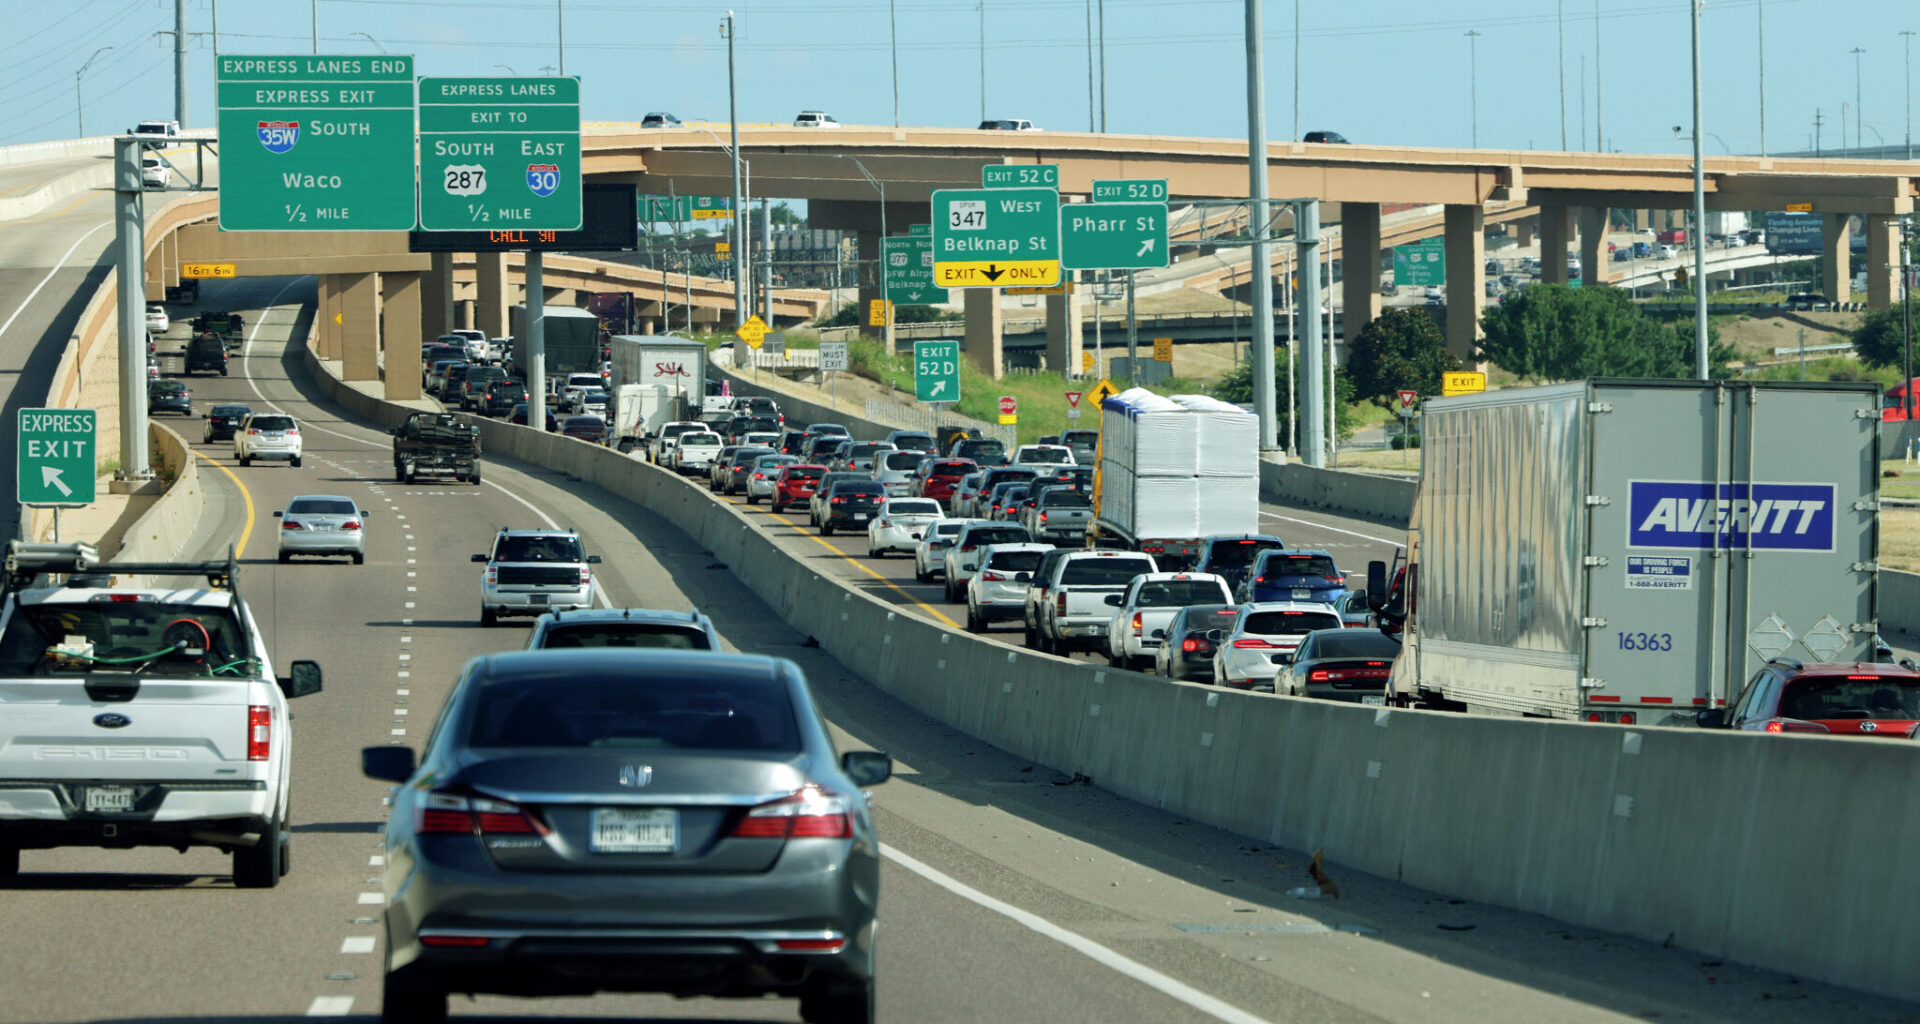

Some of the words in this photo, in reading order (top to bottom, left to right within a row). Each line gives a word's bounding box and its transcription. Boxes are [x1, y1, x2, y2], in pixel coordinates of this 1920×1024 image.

[223, 60, 298, 74] EXPRESS
[307, 60, 361, 74] LANES
[371, 60, 406, 73] END
[256, 90, 329, 104] EXPRESS
[339, 90, 375, 104] EXIT
[441, 84, 503, 96] EXPRESS
[511, 84, 556, 96] LANES
[471, 112, 504, 123] EXIT
[508, 112, 527, 123] TO
[310, 120, 370, 136] SOUTH
[261, 129, 296, 145] 35W
[435, 140, 494, 156] SOUTH
[521, 141, 565, 155] EAST
[283, 172, 341, 189] Waco
[446, 170, 484, 189] 287
[531, 173, 556, 190] 30
[987, 171, 1012, 182] EXIT
[1019, 169, 1040, 183] 52
[1043, 169, 1054, 183] C
[1096, 186, 1122, 197] EXIT
[1128, 184, 1149, 198] 52
[1152, 184, 1163, 198] D
[316, 207, 349, 219] MILE
[499, 208, 531, 219] MILE
[1000, 200, 1042, 213] WEST
[951, 211, 985, 226] 347
[1073, 217, 1126, 231] Pharr
[1136, 217, 1155, 231] St
[944, 237, 1019, 254] Belknap
[1029, 237, 1047, 250] St
[945, 268, 975, 280] EXIT
[1010, 267, 1048, 279] ONLY
[823, 351, 844, 359] MUST
[921, 347, 951, 357] EXIT
[919, 361, 940, 375] 52
[943, 361, 954, 375] D
[1452, 378, 1476, 387] EXIT
[22, 414, 93, 433] EXPRESS
[28, 440, 87, 458] EXIT
[1638, 497, 1825, 535] AVERITT
[1618, 632, 1672, 652] 16363
